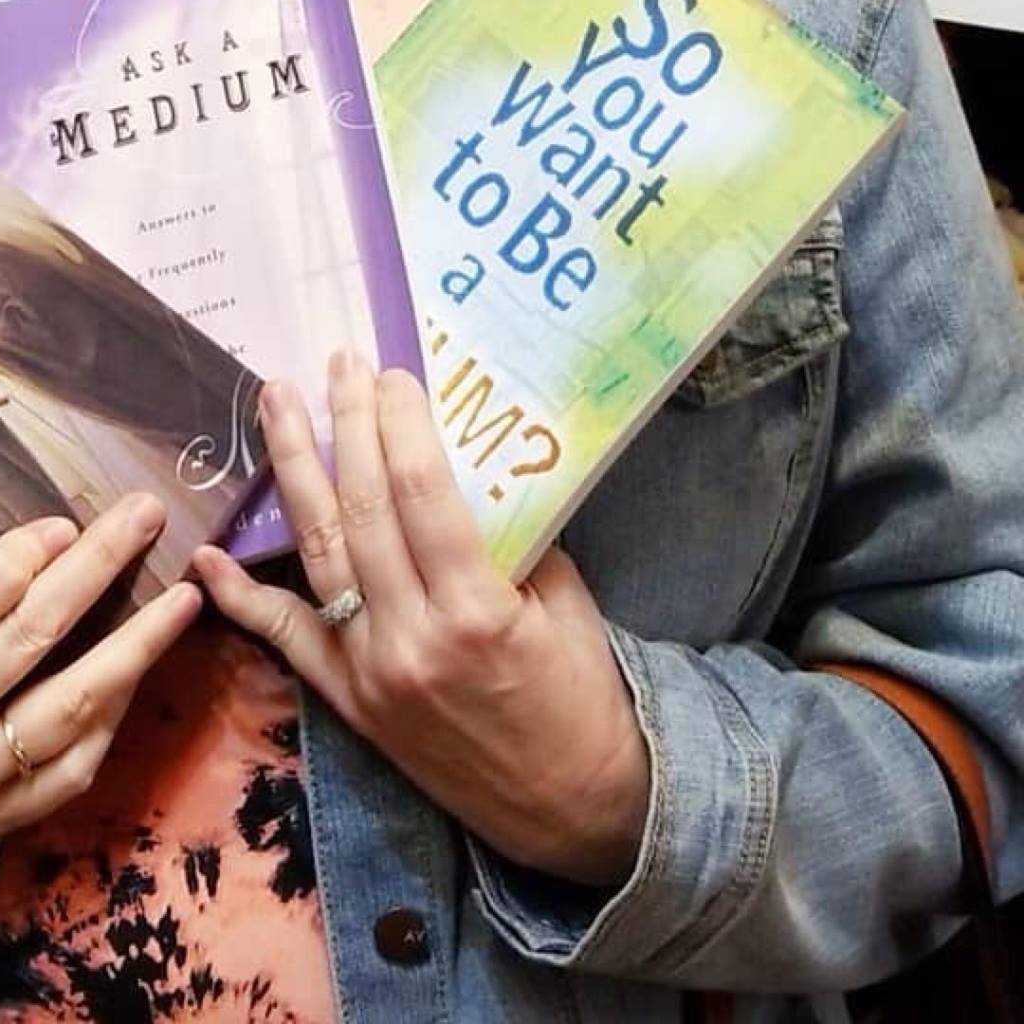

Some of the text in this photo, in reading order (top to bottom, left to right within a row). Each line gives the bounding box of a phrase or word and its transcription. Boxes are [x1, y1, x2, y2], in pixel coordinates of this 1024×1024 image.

[120, 29, 239, 82] ASK A
[49, 53, 310, 166] MEDIUM
[562, 20, 689, 168] You
[137, 204, 217, 235] Answers to
[432, 131, 598, 312] to Be
[148, 247, 226, 279] Frequently
[440, 253, 487, 304] a
[185, 296, 237, 318] estions
